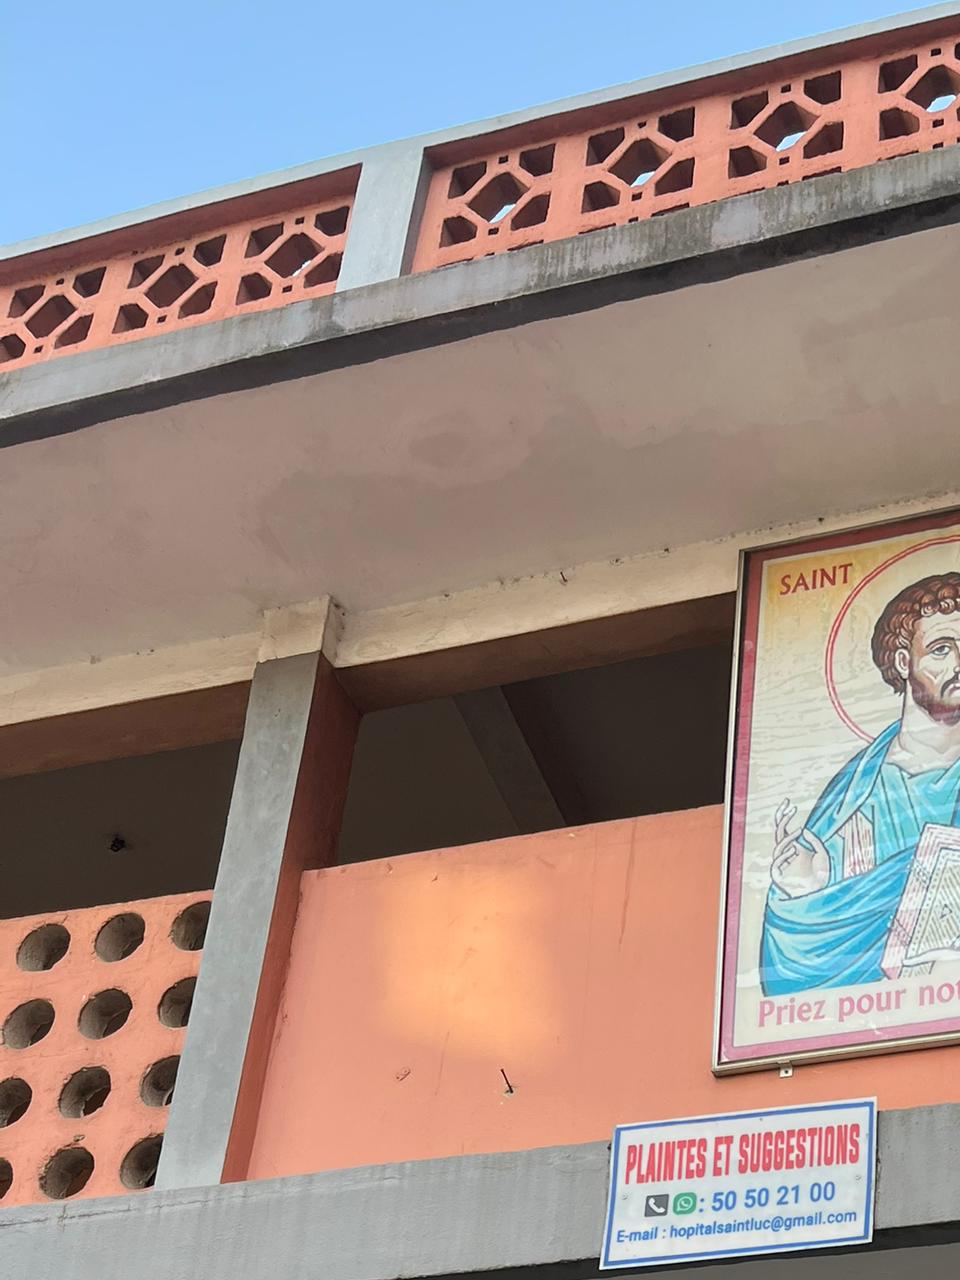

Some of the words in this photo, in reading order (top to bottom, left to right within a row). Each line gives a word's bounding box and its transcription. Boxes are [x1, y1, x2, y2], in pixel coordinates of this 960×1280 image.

[779, 563, 853, 596] SAINT
[758, 999, 825, 1028] Priez
[837, 989, 905, 1022] pour
[625, 1138, 706, 1185] PLAINTES
[712, 1135, 734, 1177] ET
[738, 1123, 860, 1174] SUGGESTIONS
[711, 1192, 737, 1212] 50
[744, 1188, 770, 1209] 50
[776, 1185, 800, 1206] 21
[809, 1181, 836, 1202] 00
[616, 1226, 658, 1243] E-mail
[670, 1211, 857, 1240] hopitalsaintluc@gmail.com
